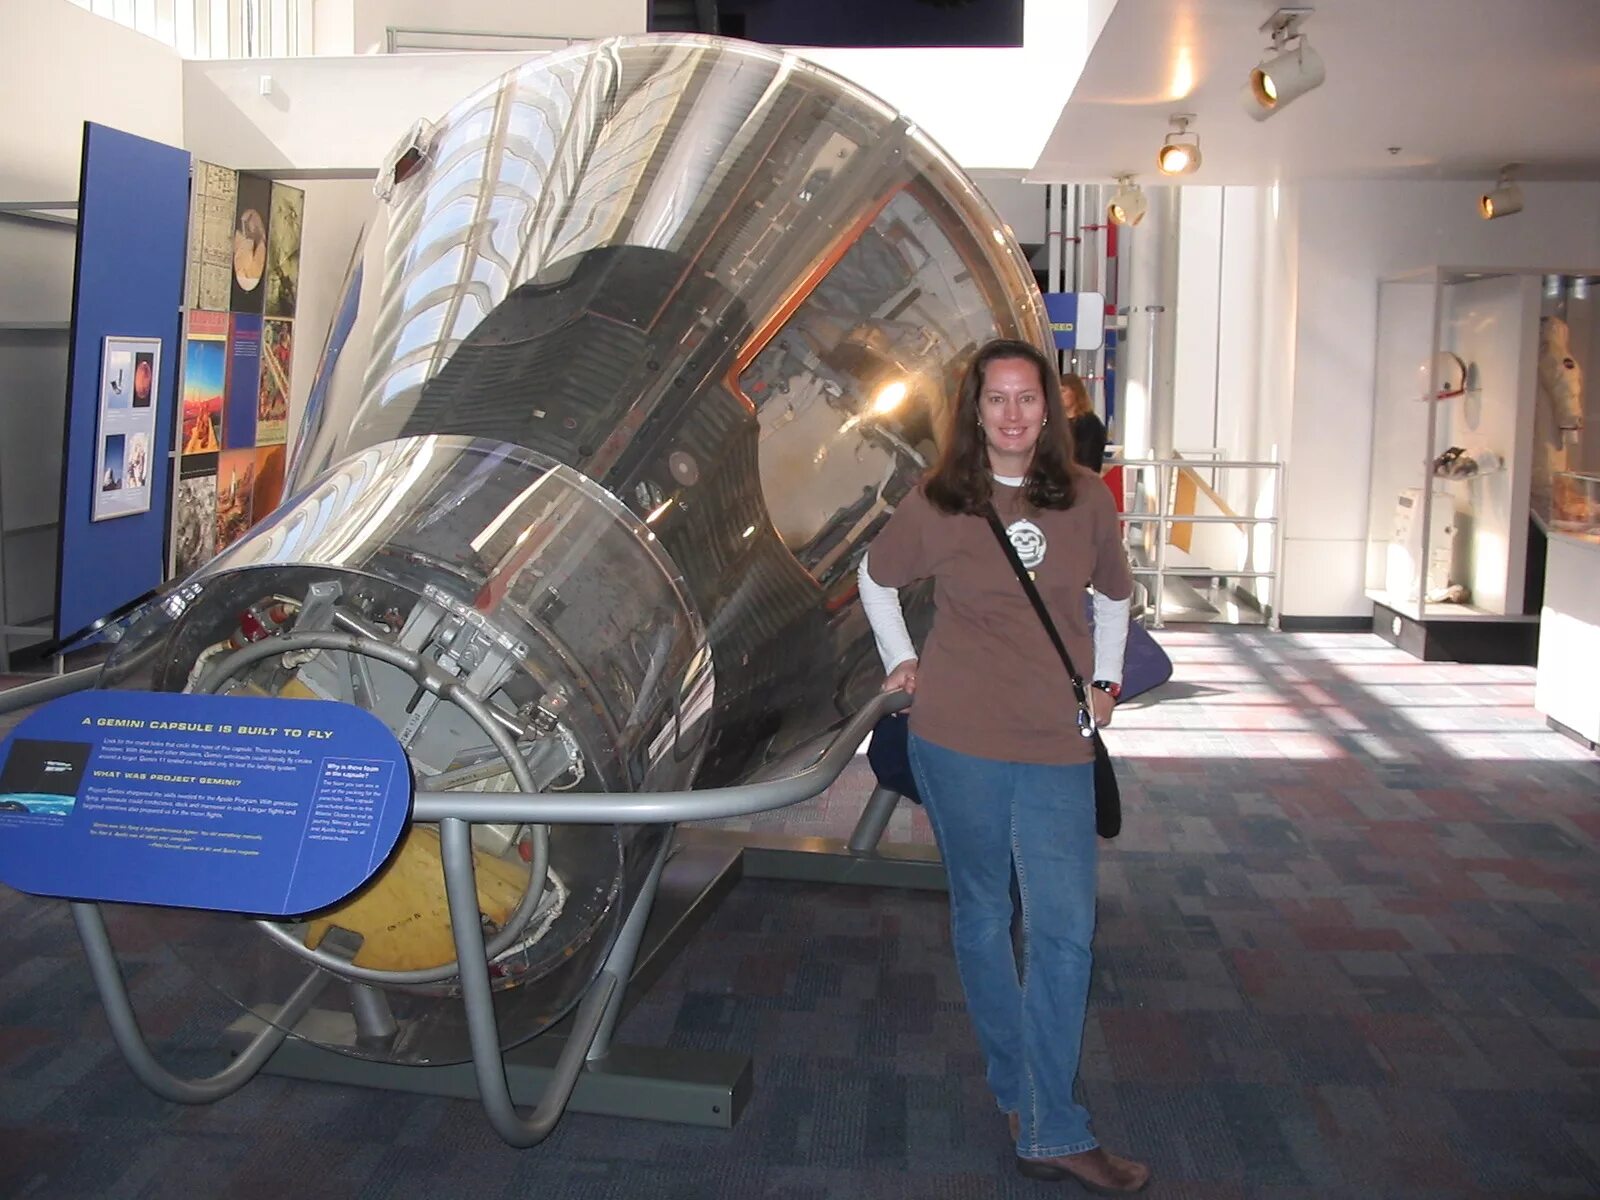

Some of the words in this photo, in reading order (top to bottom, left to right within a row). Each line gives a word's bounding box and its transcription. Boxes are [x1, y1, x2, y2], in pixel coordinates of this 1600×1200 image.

[82, 717, 91, 725] A
[97, 718, 145, 729] GEMINI
[149, 721, 214, 733] CAPSULE
[218, 725, 232, 733] IS
[238, 726, 278, 736] BUILT
[284, 728, 302, 738] TO
[307, 730, 333, 739] FLY
[93, 770, 121, 778] WHAT
[150, 774, 196, 783] PROJECT
[199, 777, 241, 787] GEMINI?
